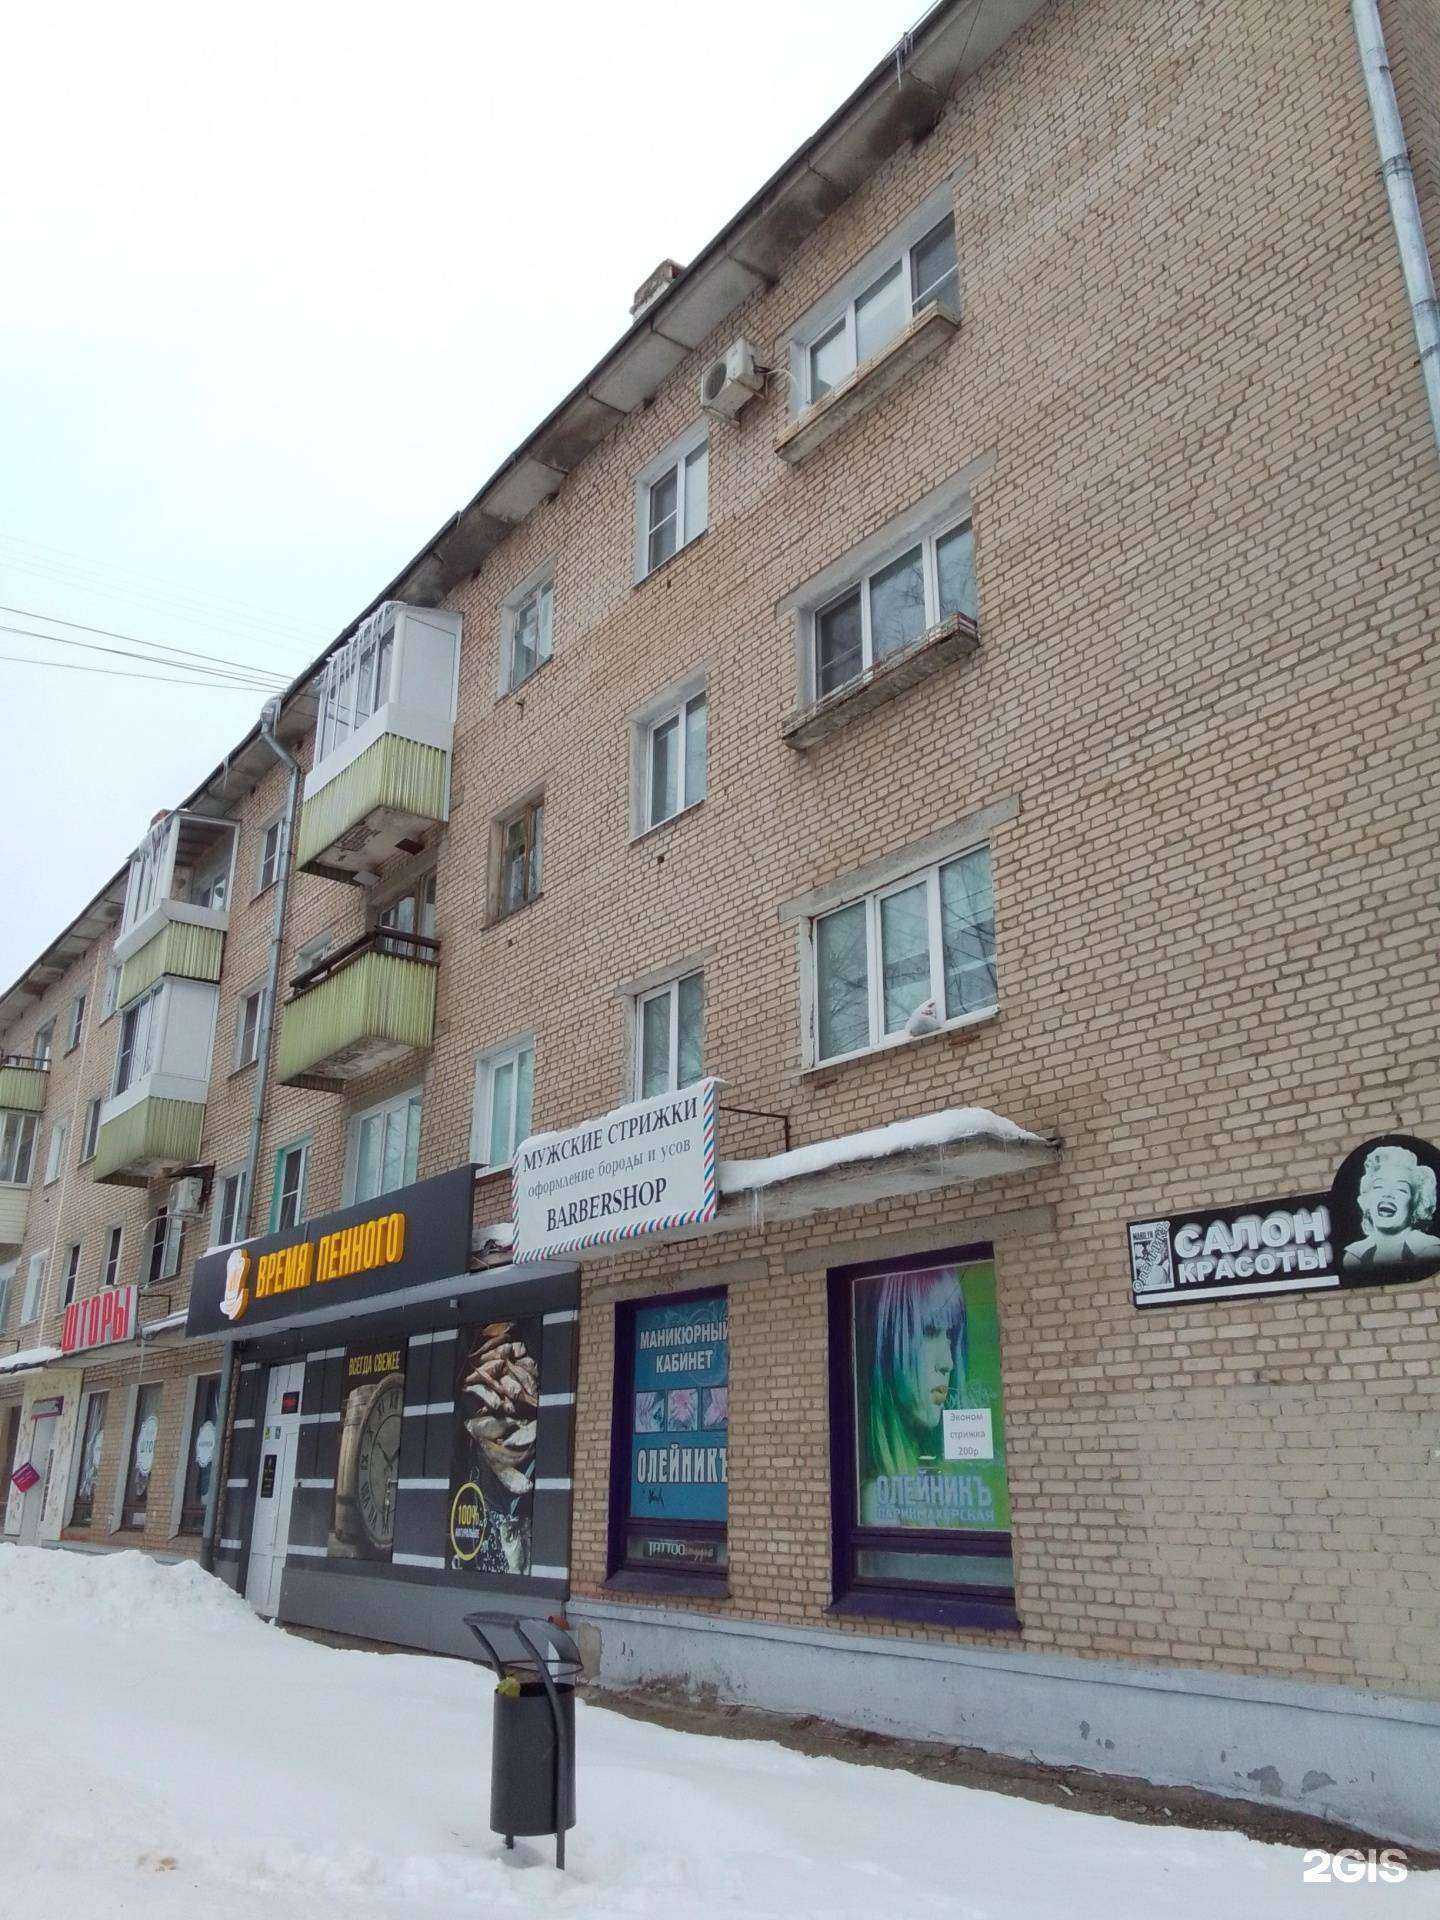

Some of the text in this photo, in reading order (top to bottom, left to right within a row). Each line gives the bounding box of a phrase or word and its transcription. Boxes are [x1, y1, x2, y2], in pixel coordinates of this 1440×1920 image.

[523, 1097, 698, 1173] МУЖСКИЕ СТРИЖКИ
[528, 1138, 691, 1199] оформление бороды и усов
[546, 1177, 667, 1232] BARBERSHOP
[255, 1212, 406, 1298] ВРЕМЯ ПЕННОГО
[1174, 1209, 1328, 1258] САЛОН
[1178, 1247, 1328, 1284] КРАСОТЫ
[62, 1286, 131, 1352] ШТОРЫ
[640, 1318, 729, 1350] МАНИКЮРНЫЙ
[656, 1350, 714, 1373] КАБИНЕТ
[458, 1504, 480, 1526] 100%
[648, 1541, 685, 1557] TATTOO
